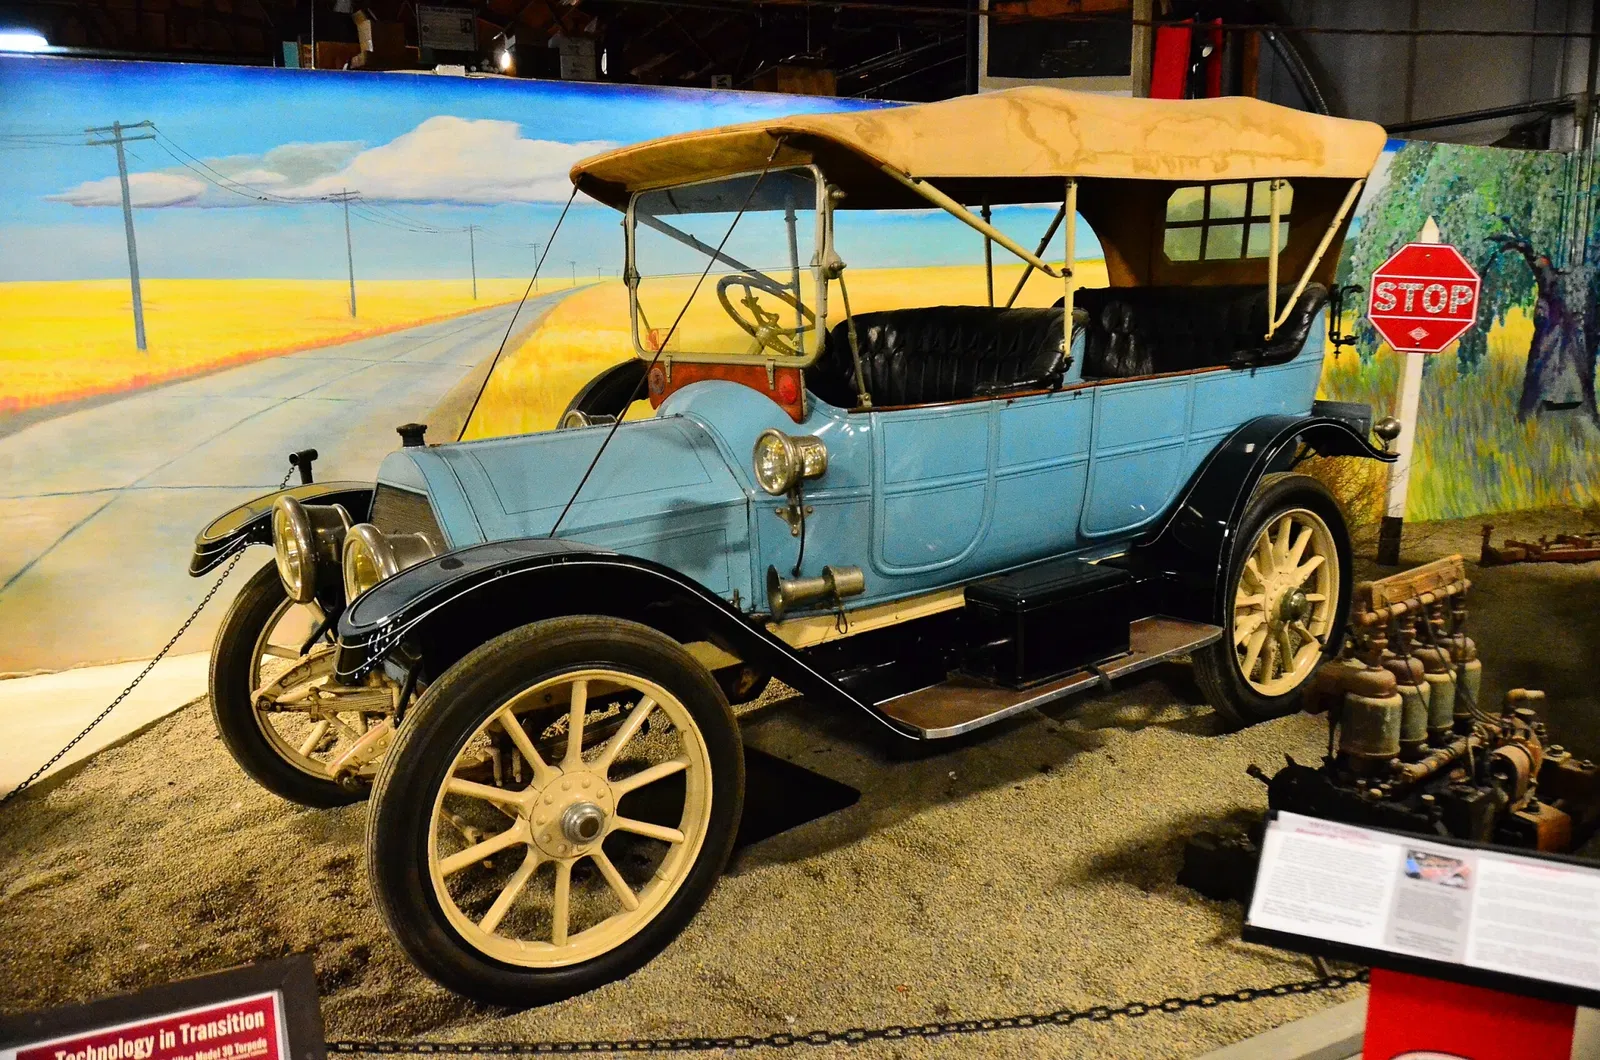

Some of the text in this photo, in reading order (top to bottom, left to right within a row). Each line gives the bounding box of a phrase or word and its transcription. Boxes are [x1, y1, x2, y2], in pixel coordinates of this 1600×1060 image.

[1374, 281, 1473, 314] STOP
[160, 1028, 175, 1049] in
[179, 1010, 265, 1044] Transition
[195, 1047, 221, 1060] Model
[234, 1037, 268, 1054] Torpedo
